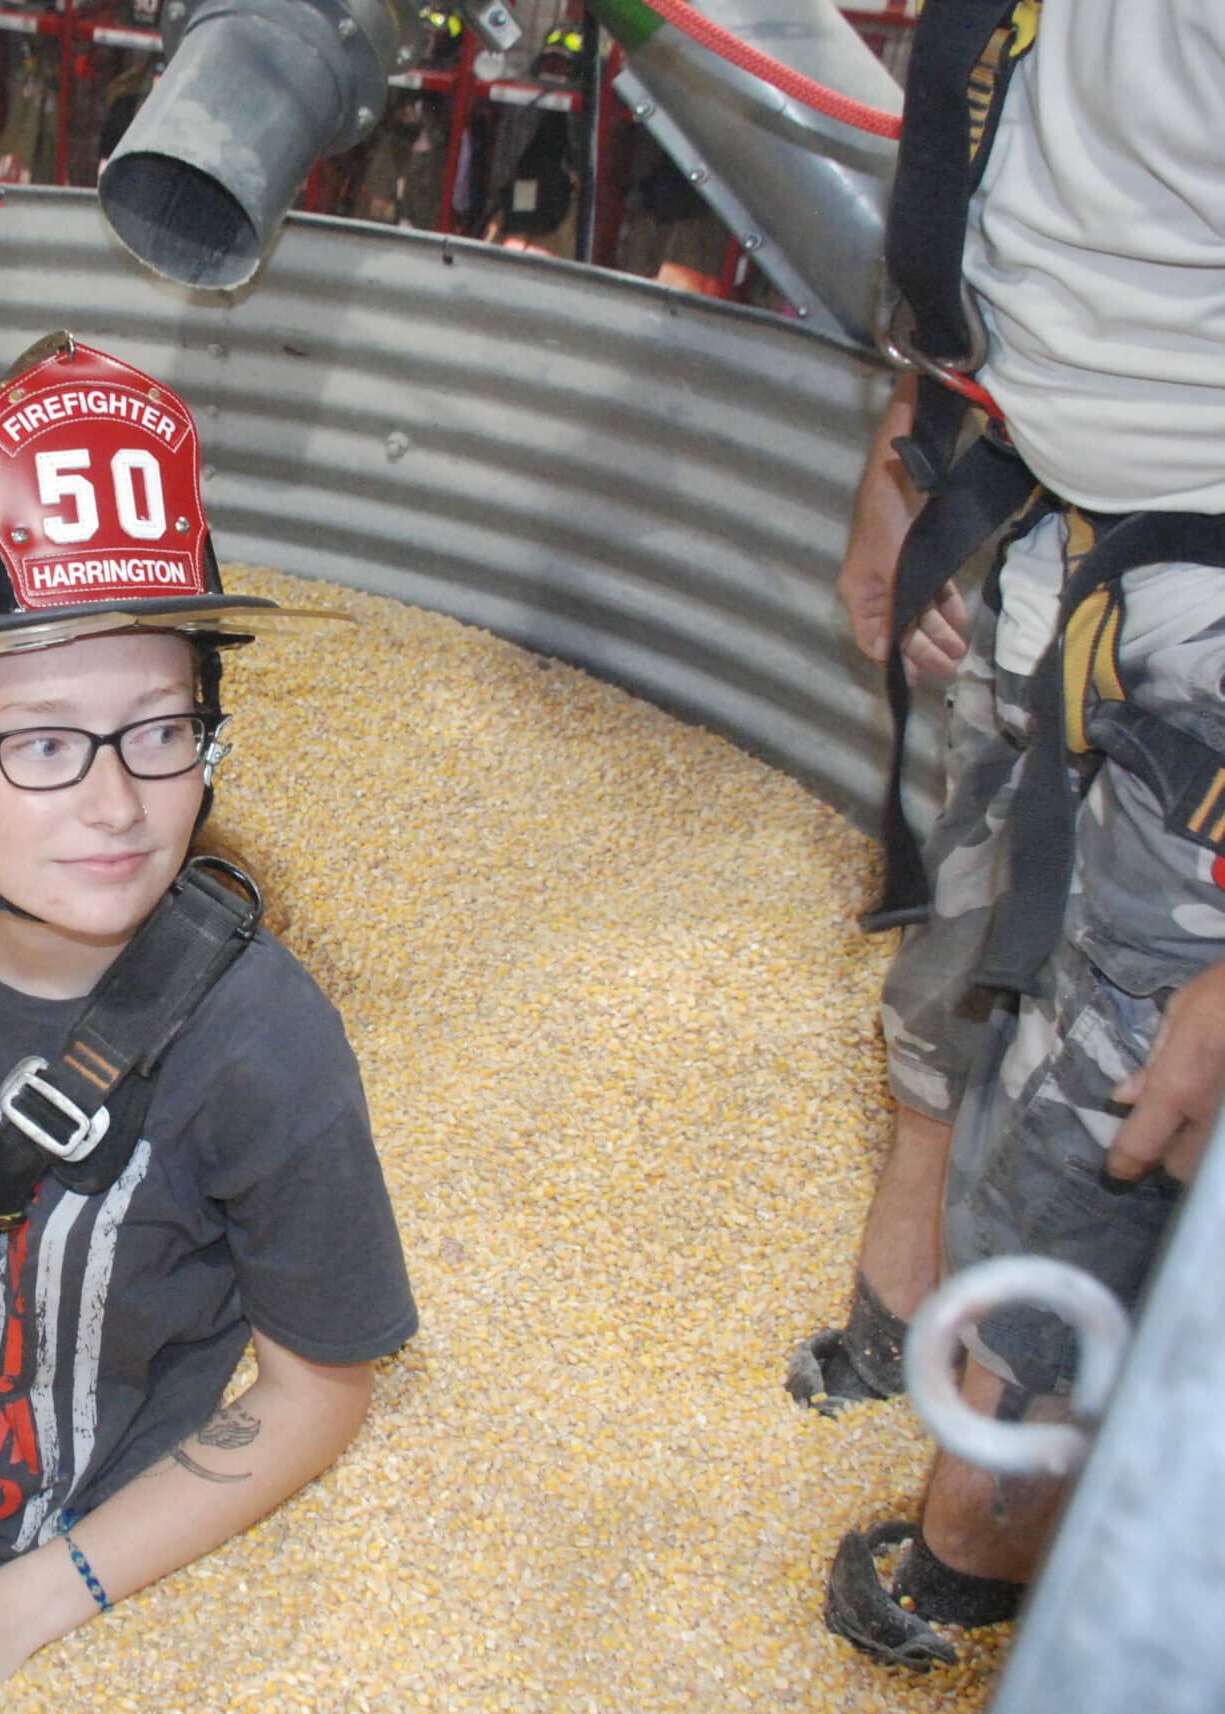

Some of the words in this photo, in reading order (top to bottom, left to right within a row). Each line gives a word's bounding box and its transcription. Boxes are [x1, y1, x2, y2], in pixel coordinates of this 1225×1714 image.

[2, 391, 176, 442] FIREFIGHTER
[35, 448, 167, 544] 50
[32, 559, 186, 589] HARRINGTON
